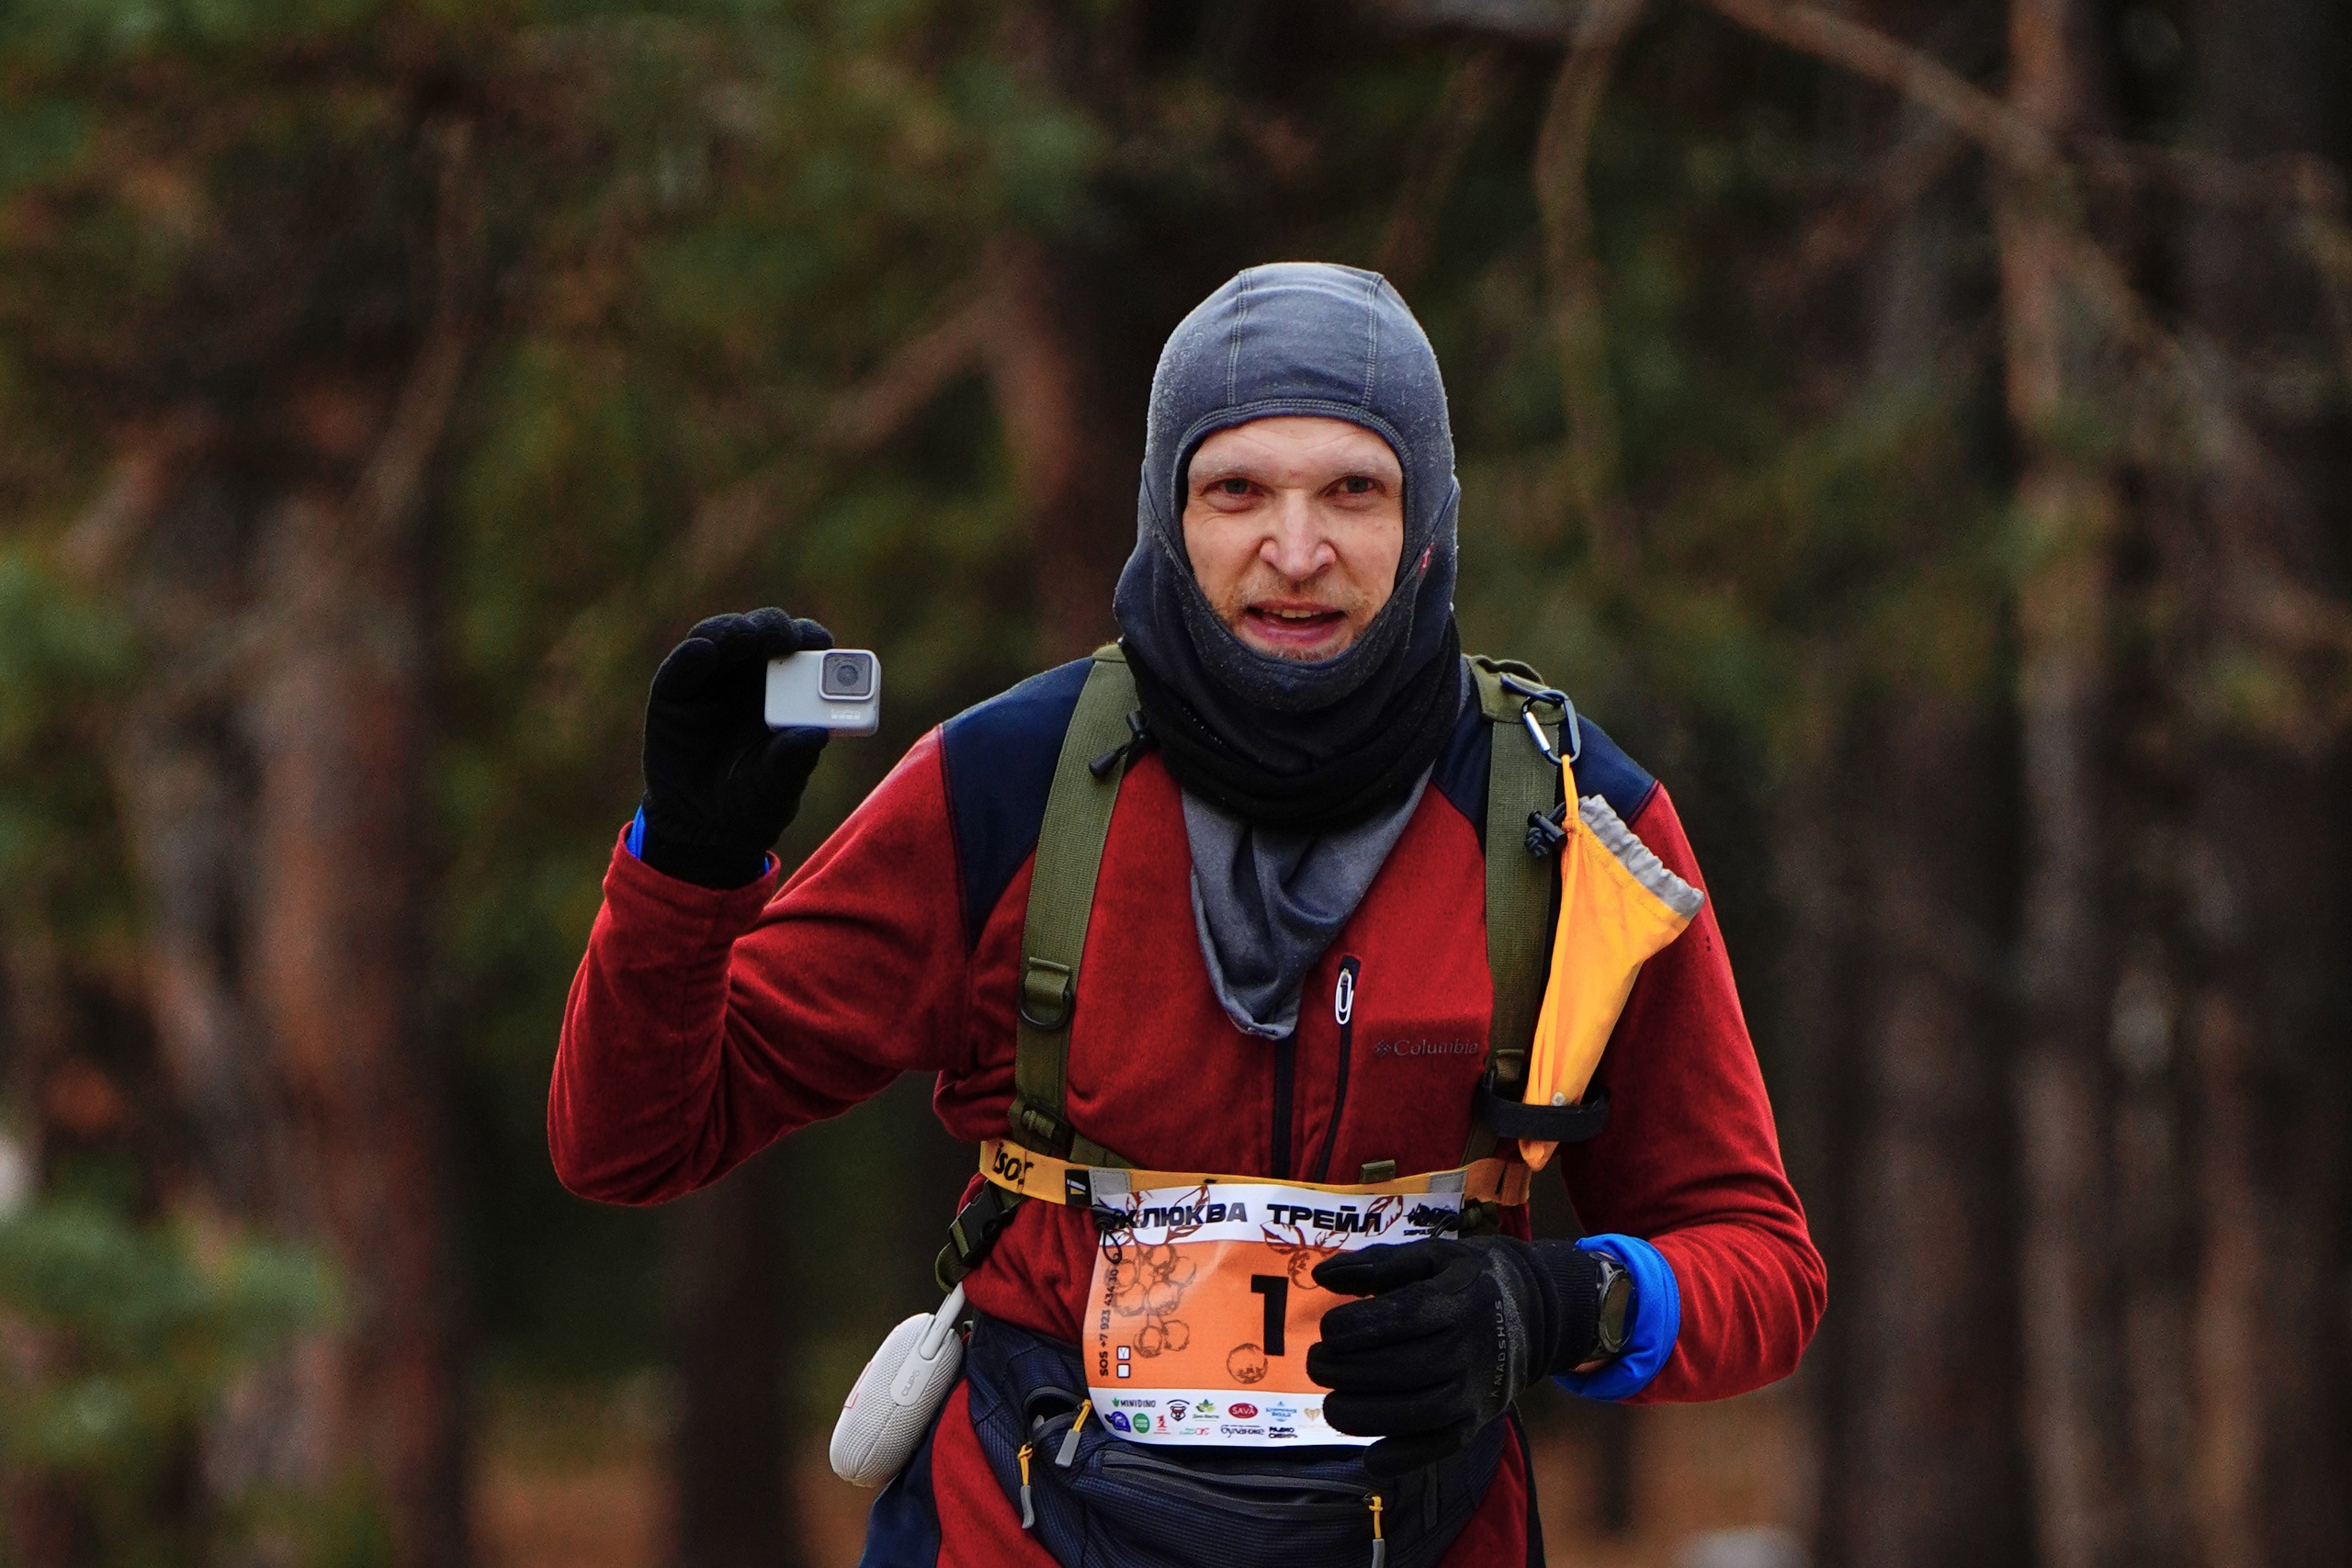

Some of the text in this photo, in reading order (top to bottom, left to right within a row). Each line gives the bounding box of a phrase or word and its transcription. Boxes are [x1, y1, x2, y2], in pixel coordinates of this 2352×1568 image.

[1394, 1039, 1478, 1056] Columbia
[1267, 1203, 1382, 1233] ТРЕЙЛ
[1104, 1285, 1115, 1306] 434
[1100, 1309, 1111, 1330] 923
[1250, 1273, 1289, 1357] 1
[1100, 1333, 1108, 1348] +7
[1494, 1300, 1507, 1386] MADSHUS
[1099, 1350, 1109, 1377] SOS
[1120, 1399, 1157, 1409] MINIDINO
